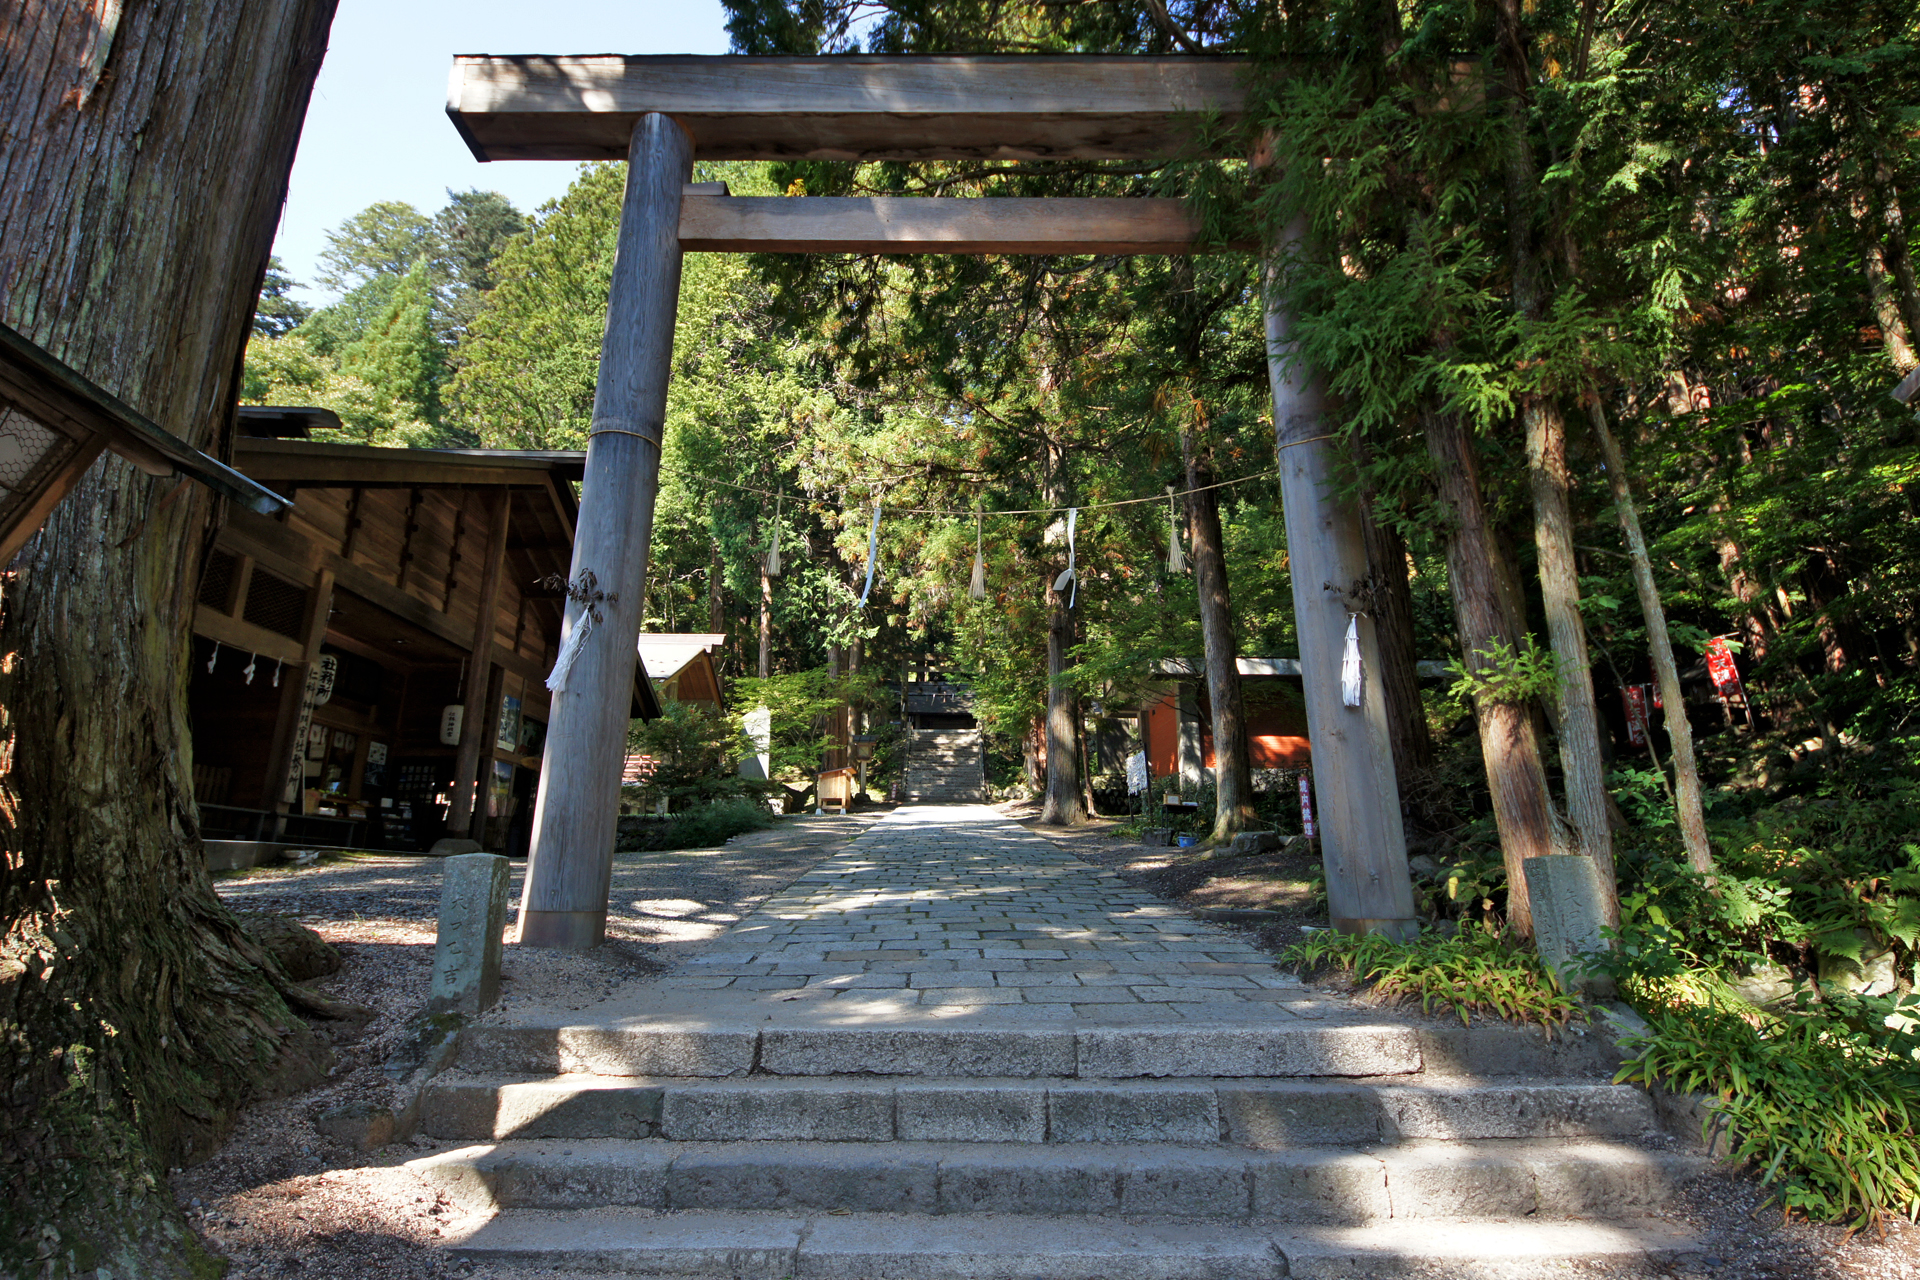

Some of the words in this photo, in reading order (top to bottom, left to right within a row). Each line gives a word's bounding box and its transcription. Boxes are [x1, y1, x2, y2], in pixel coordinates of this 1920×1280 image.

[316, 657, 336, 700] 社務所
[1299, 779, 1314, 836] 境内禁煙
